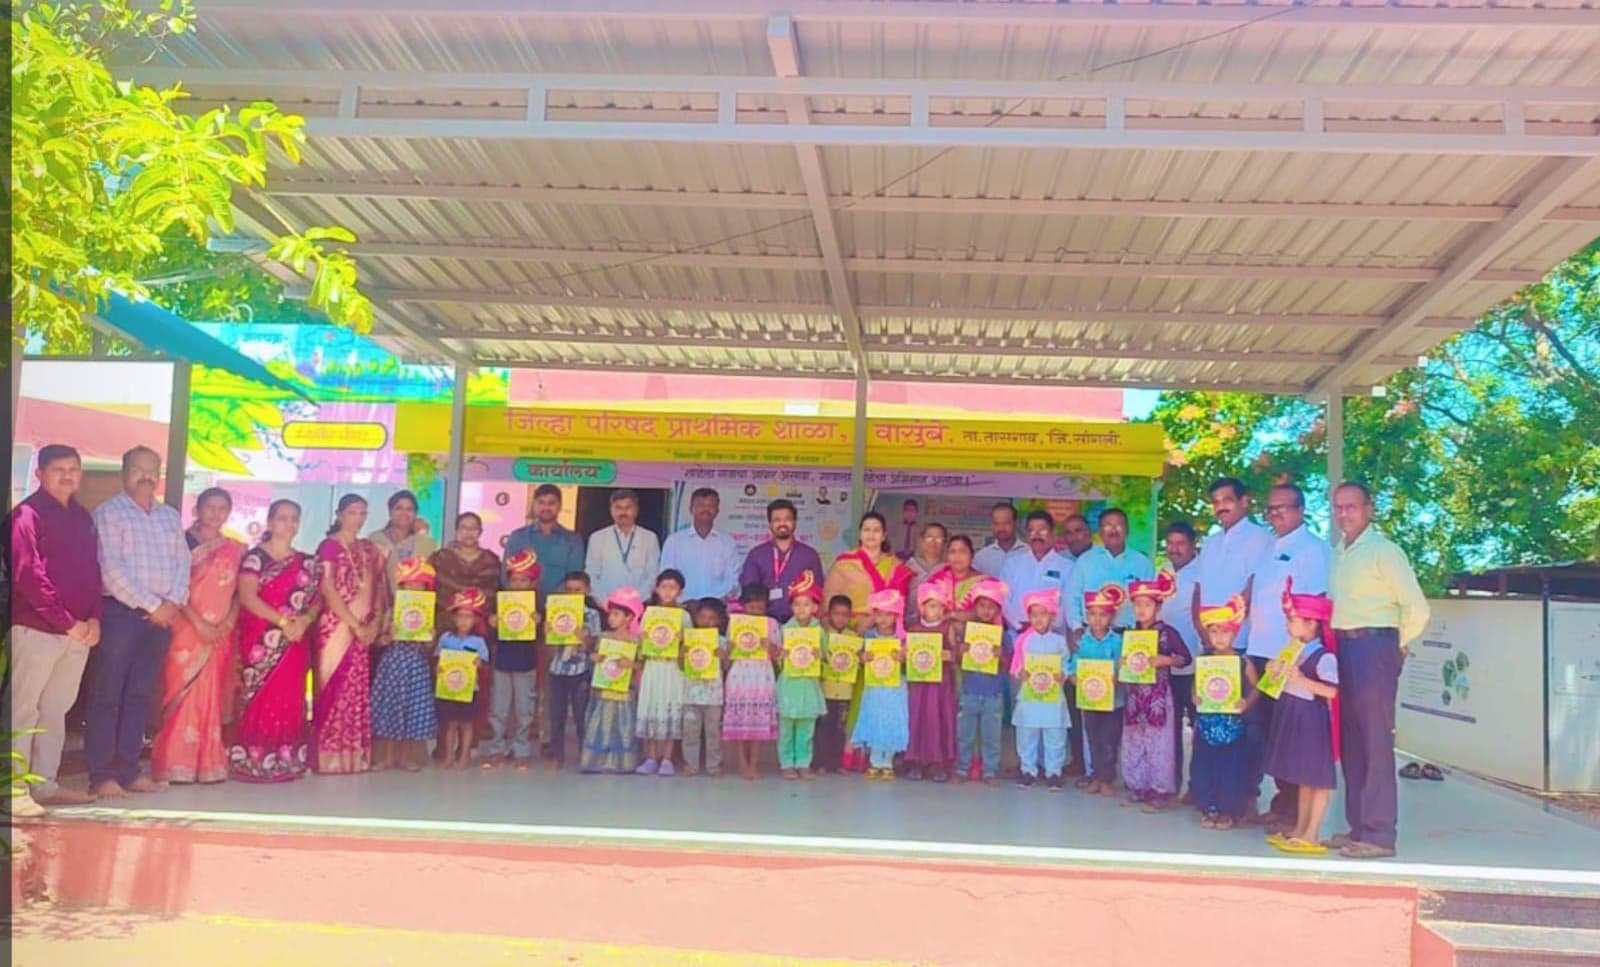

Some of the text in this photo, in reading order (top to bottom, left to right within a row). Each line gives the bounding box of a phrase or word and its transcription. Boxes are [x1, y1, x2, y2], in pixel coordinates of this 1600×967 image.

[504, 406, 576, 436] जिल्हा
[584, 410, 656, 436] परिषद
[666, 412, 763, 440] प्राथमिक
[774, 419, 849, 442] शाळा,
[527, 459, 602, 478] कार्यालय
